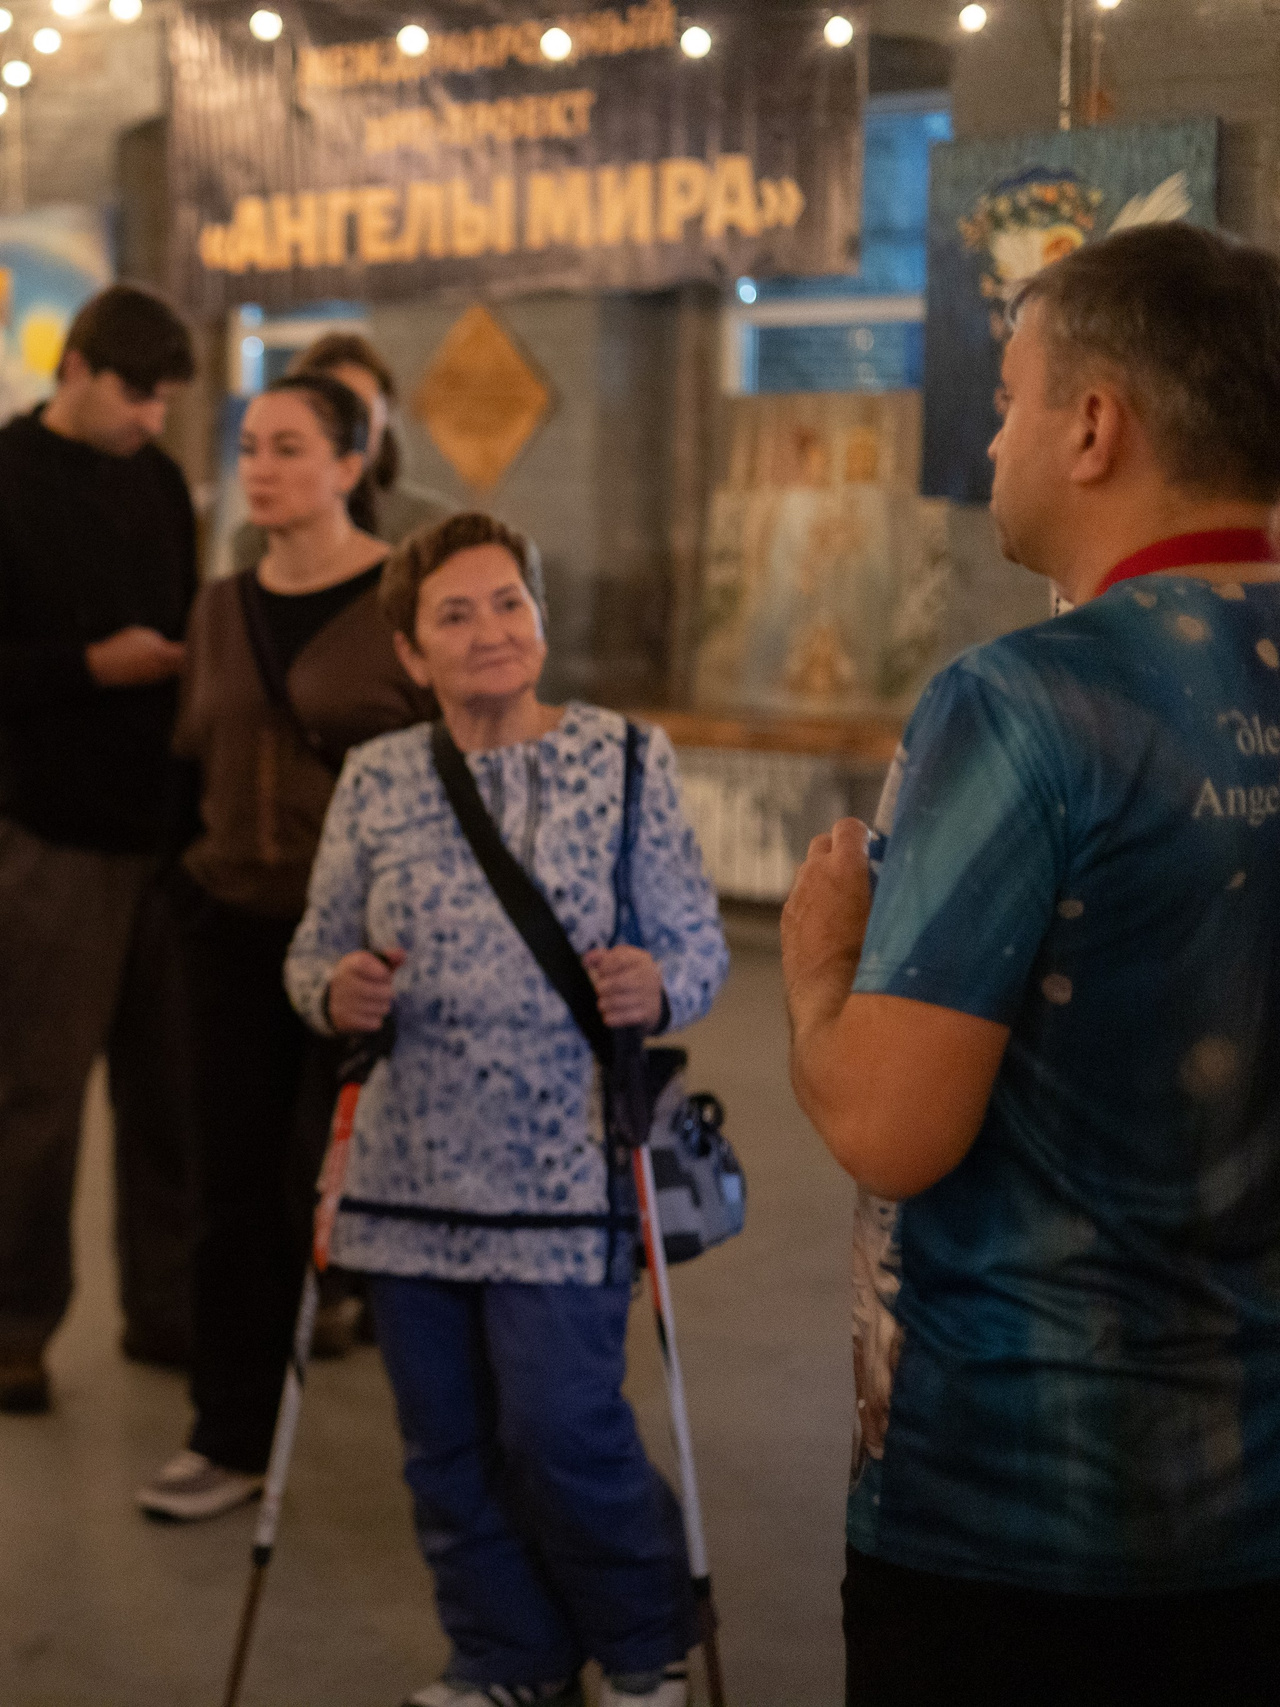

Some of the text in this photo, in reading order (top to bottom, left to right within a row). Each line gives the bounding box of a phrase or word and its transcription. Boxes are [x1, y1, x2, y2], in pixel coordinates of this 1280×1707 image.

[199, 153, 804, 273] «АНГЕЛЫ МИРА»
[1192, 777, 1280, 828] Ange
